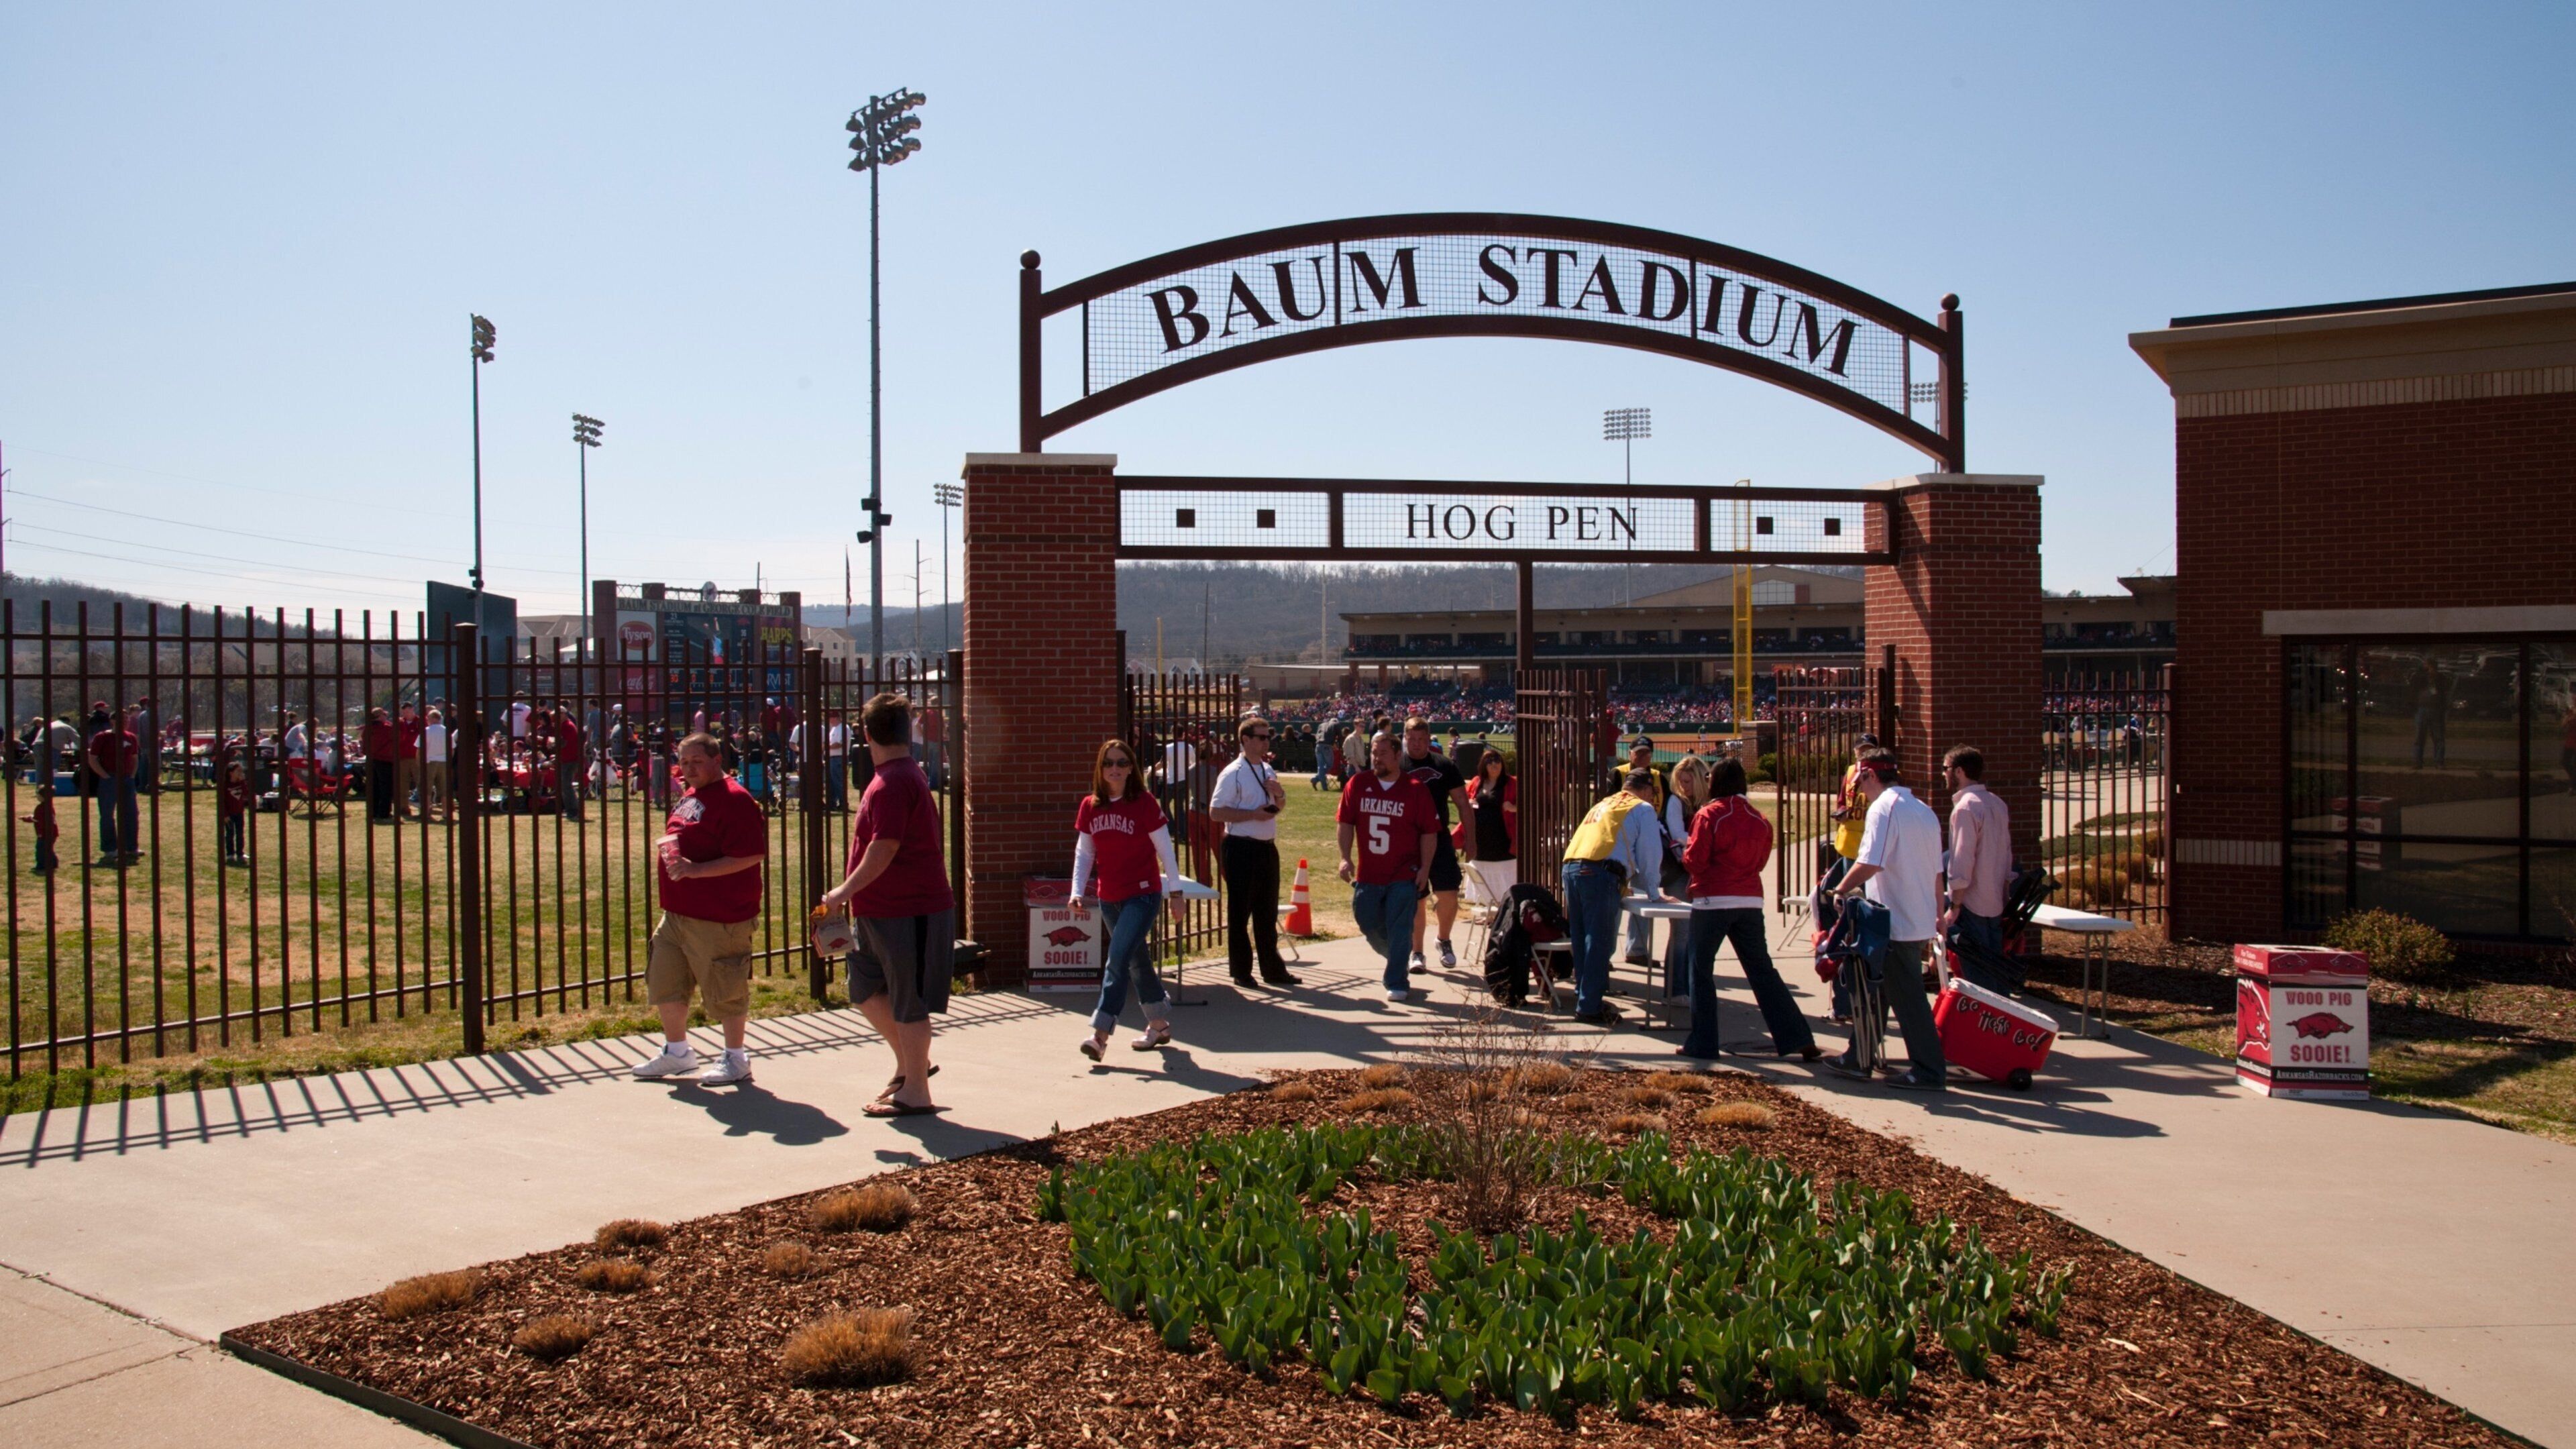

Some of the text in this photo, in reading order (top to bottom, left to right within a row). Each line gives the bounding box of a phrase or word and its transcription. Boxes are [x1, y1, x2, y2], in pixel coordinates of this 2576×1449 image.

[1144, 243, 1862, 380] BAUM STADIUM
[1405, 503, 1640, 543] HOG PEN
[619, 598, 647, 610] BAUM
[649, 601, 692, 613] STADIUM
[703, 603, 741, 615] GEORGE
[767, 606, 791, 617] FIELD
[622, 627, 652, 644] Tyson
[761, 626, 792, 644] HARPS
[1360, 798, 1404, 817] ARKANSAS
[1089, 813, 1134, 835] ARKANSAS
[1368, 816, 1390, 855] 5
[1042, 910, 1091, 921] WOOO PIG
[1044, 951, 1088, 965] SOOIE!
[2286, 991, 2353, 1006] WOOO PIG
[2290, 1044, 2350, 1064] SOOIE!
